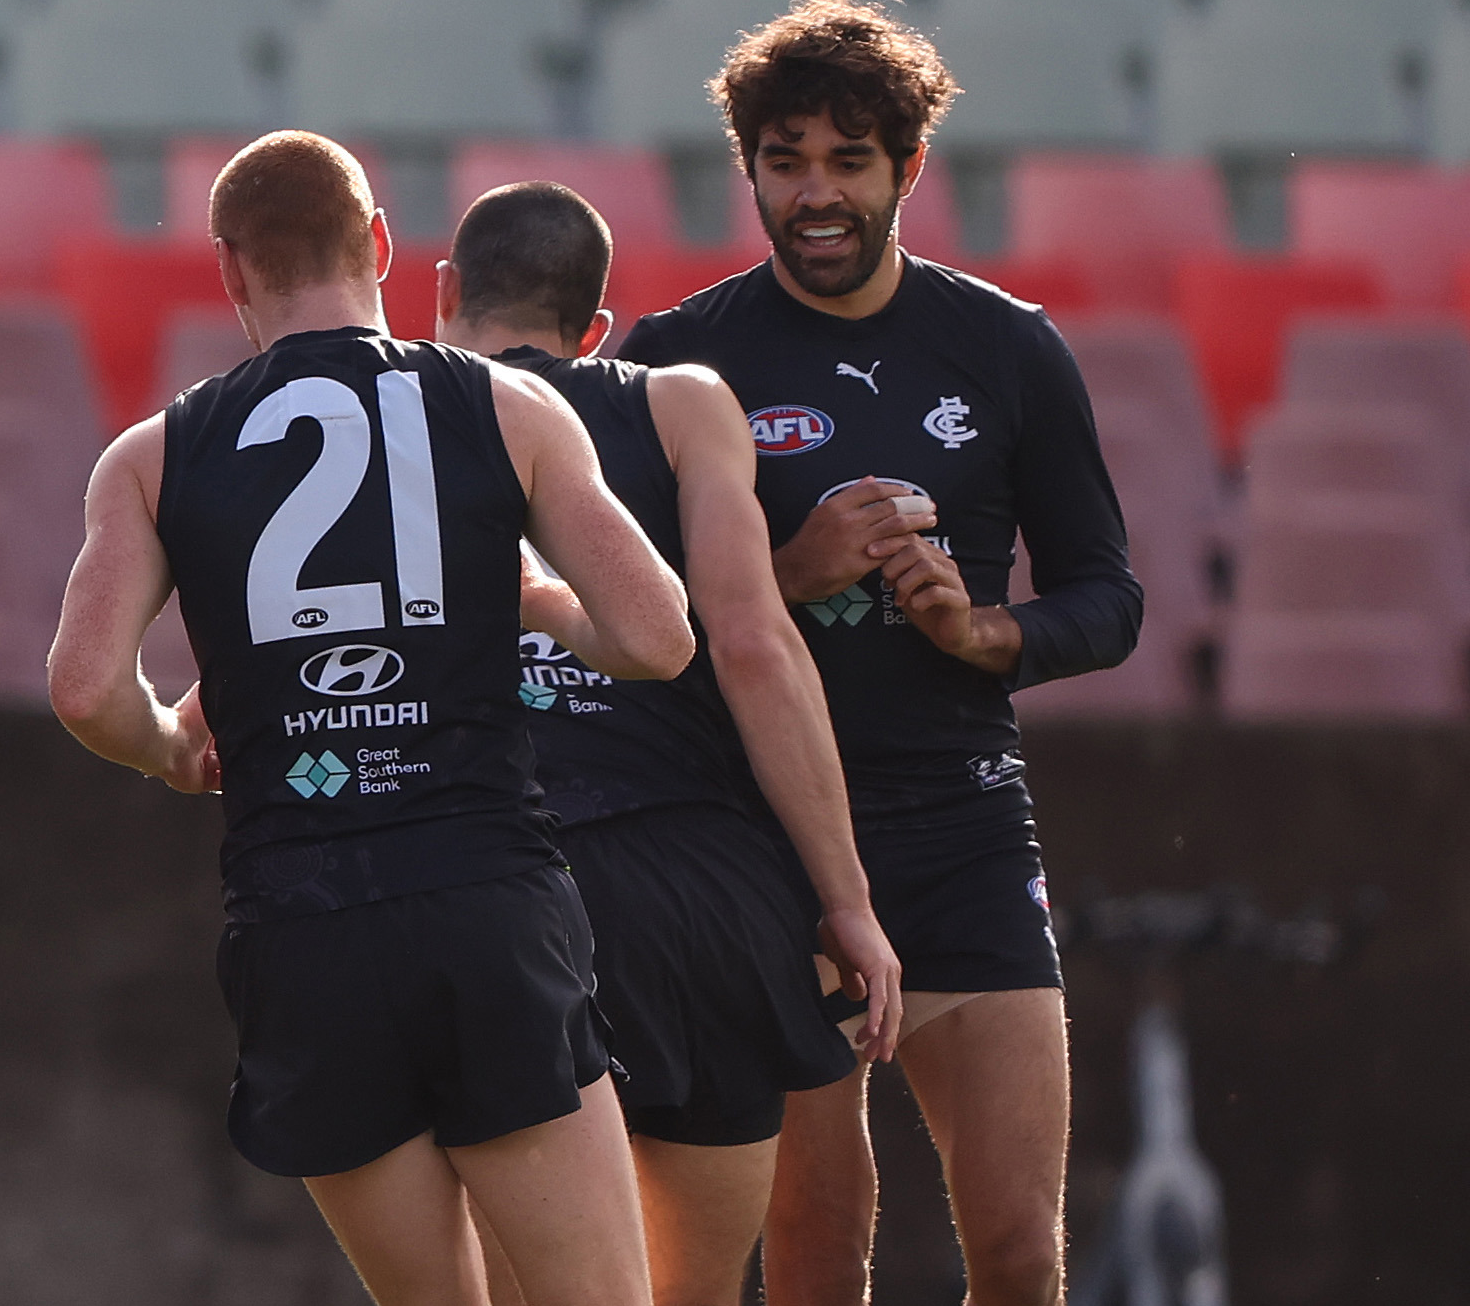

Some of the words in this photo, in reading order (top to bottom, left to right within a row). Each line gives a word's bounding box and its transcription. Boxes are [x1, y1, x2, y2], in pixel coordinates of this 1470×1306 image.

[236, 369, 446, 645] 21
[407, 601, 438, 615] AFL
[294, 611, 326, 625] AFL
[284, 700, 429, 736] HYUNDAI
[356, 747, 401, 763] Great
[358, 760, 431, 780] Southern
[360, 779, 401, 794] Bank
